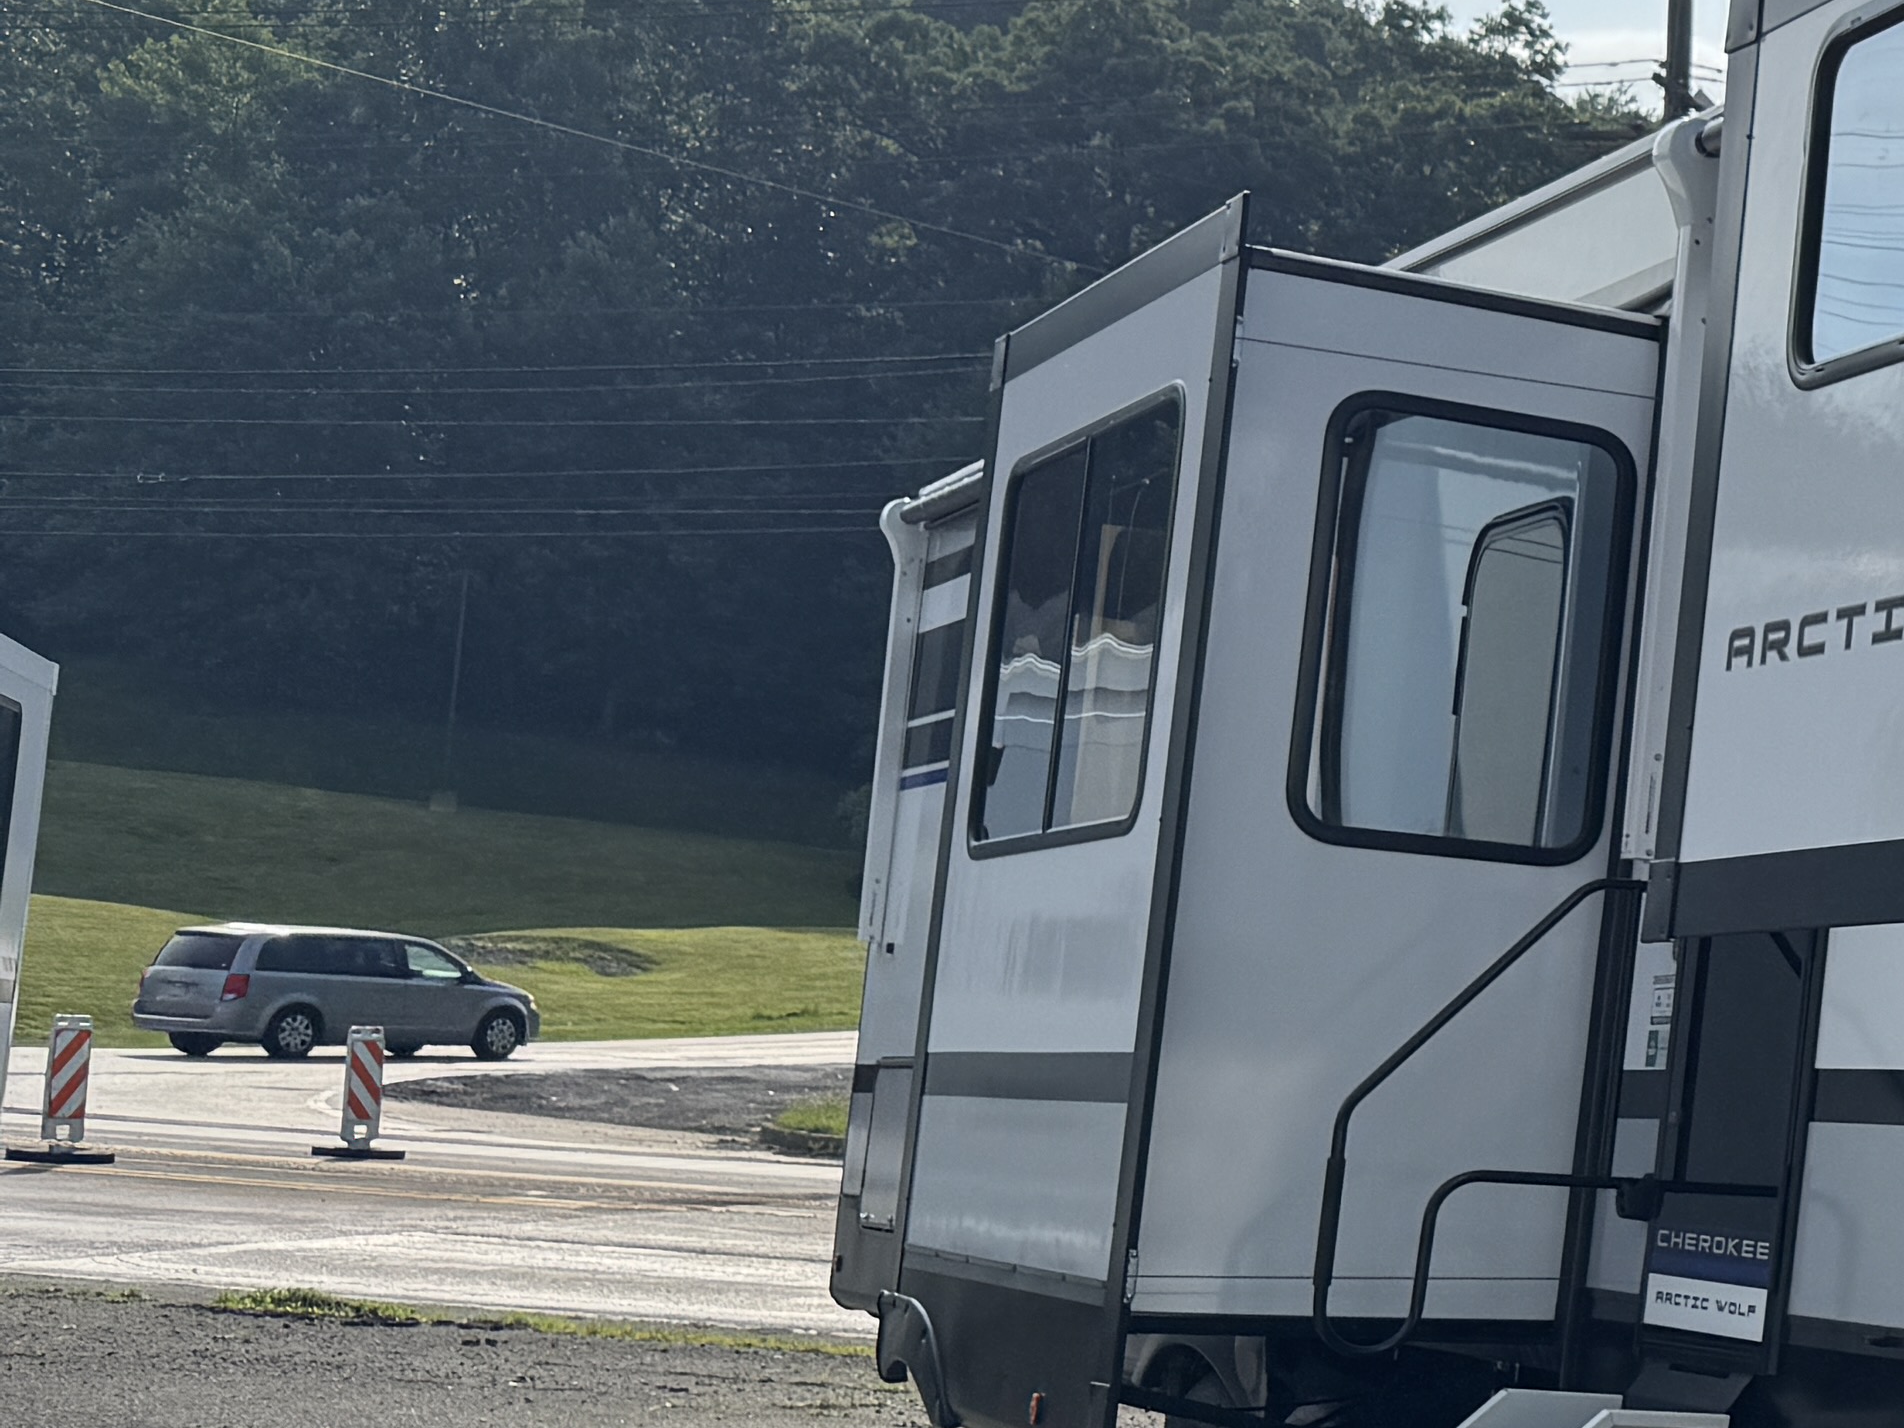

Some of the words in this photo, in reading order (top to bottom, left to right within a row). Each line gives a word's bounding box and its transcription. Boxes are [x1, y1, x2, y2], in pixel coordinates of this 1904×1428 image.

[1657, 1229, 1770, 1260] CHEROKEE
[1655, 1290, 1709, 1311] ARCTIC
[1716, 1299, 1757, 1317] WOLF
